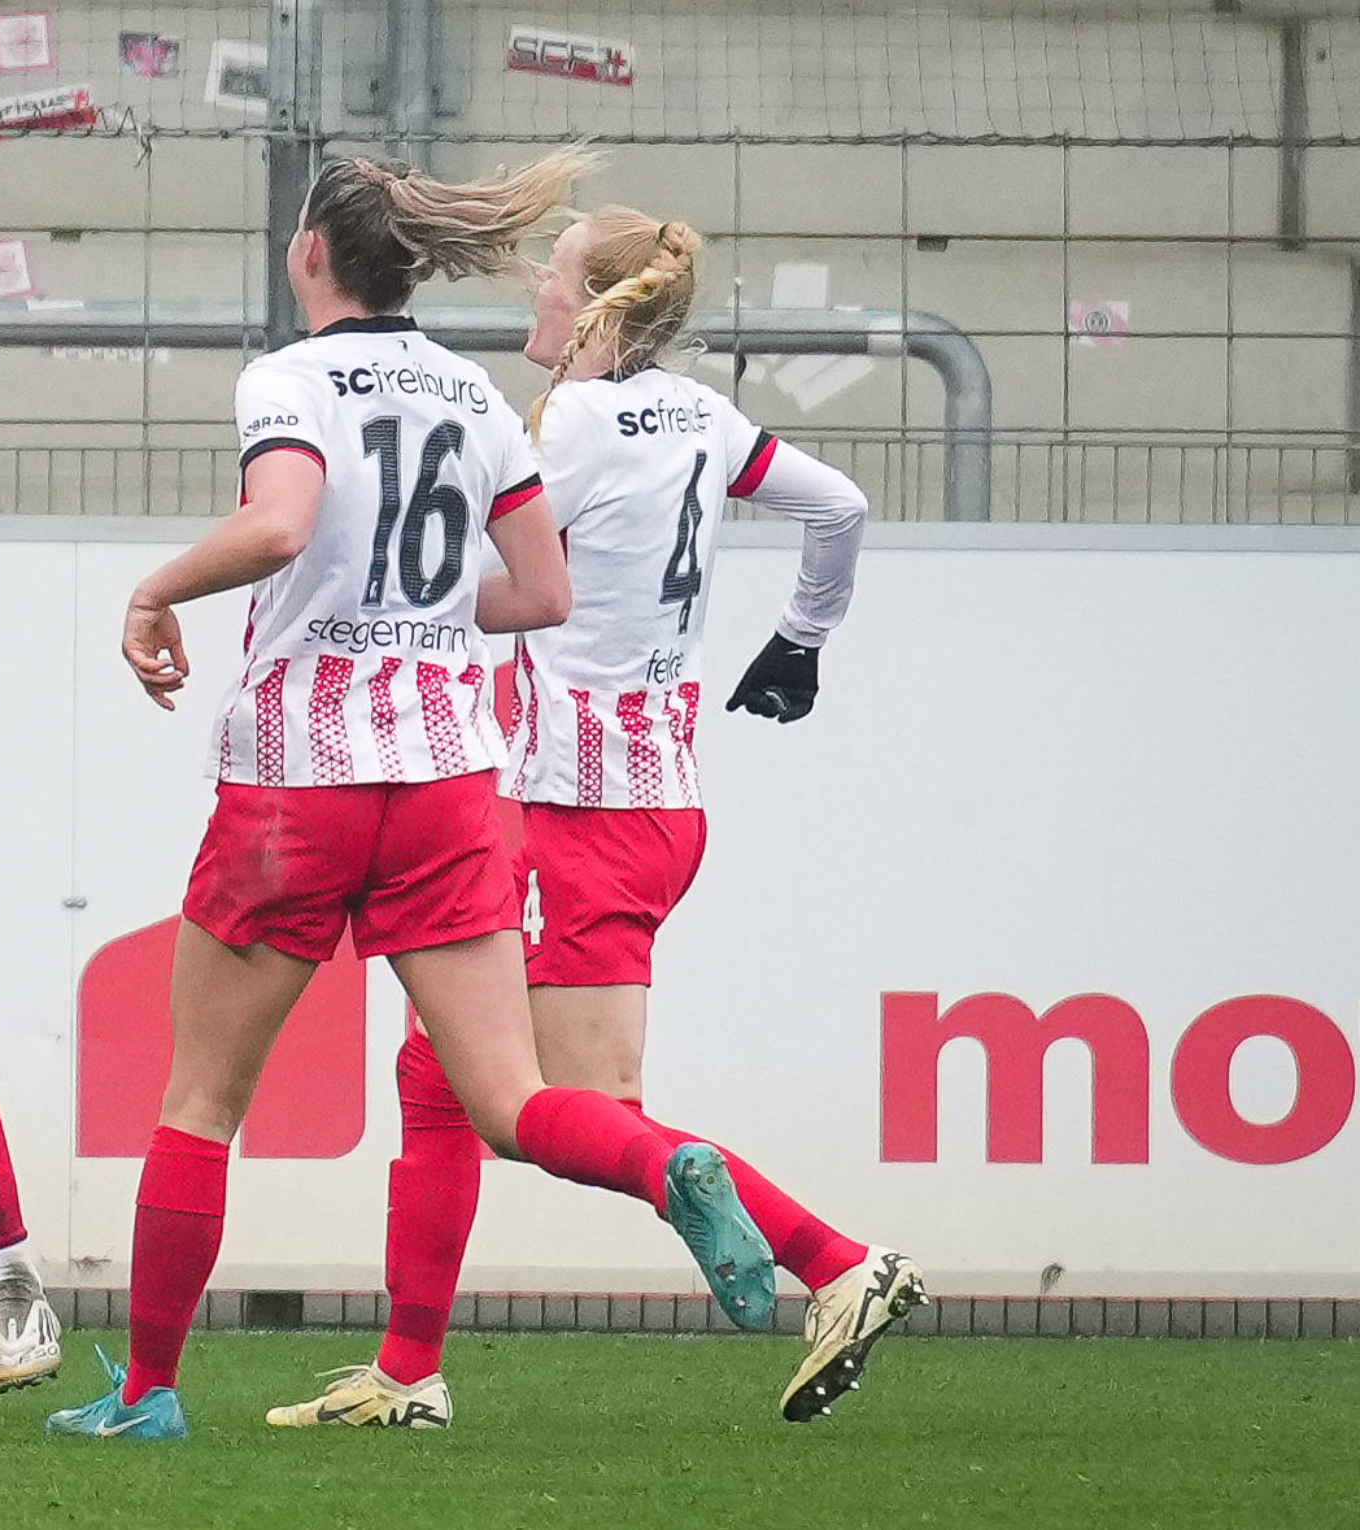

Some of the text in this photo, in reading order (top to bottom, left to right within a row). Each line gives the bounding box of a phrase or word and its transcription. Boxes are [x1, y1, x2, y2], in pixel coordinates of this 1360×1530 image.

[360, 415, 469, 609] 16
[659, 449, 707, 635] 4
[304, 614, 468, 654] stegemann
